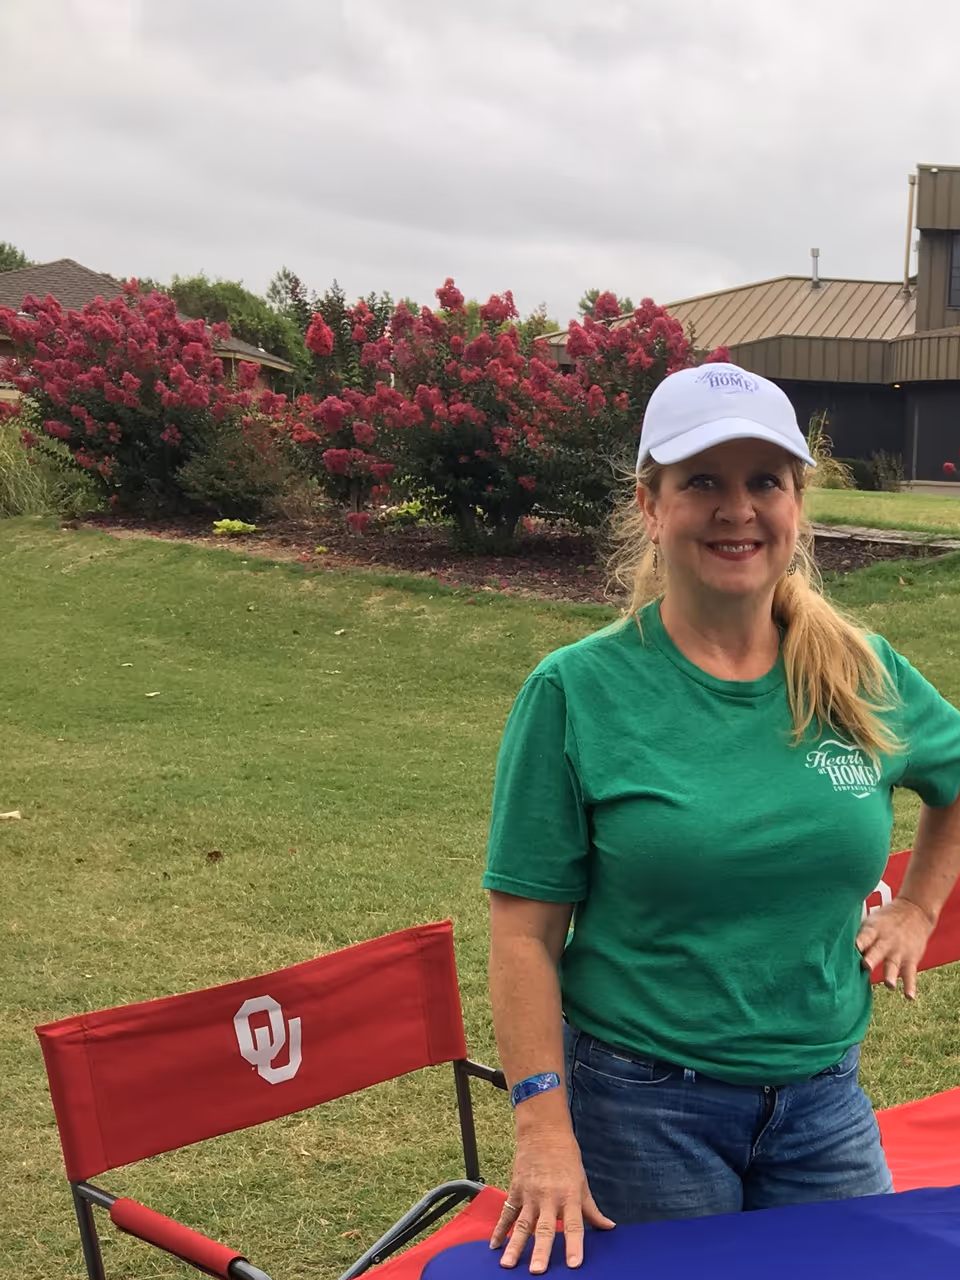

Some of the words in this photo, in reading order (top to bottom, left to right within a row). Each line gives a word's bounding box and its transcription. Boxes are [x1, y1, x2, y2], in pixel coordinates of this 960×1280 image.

[709, 376, 754, 392] HOME
[804, 749, 864, 768] Hearts
[826, 764, 877, 786] HOME
[233, 994, 303, 1085] OU
